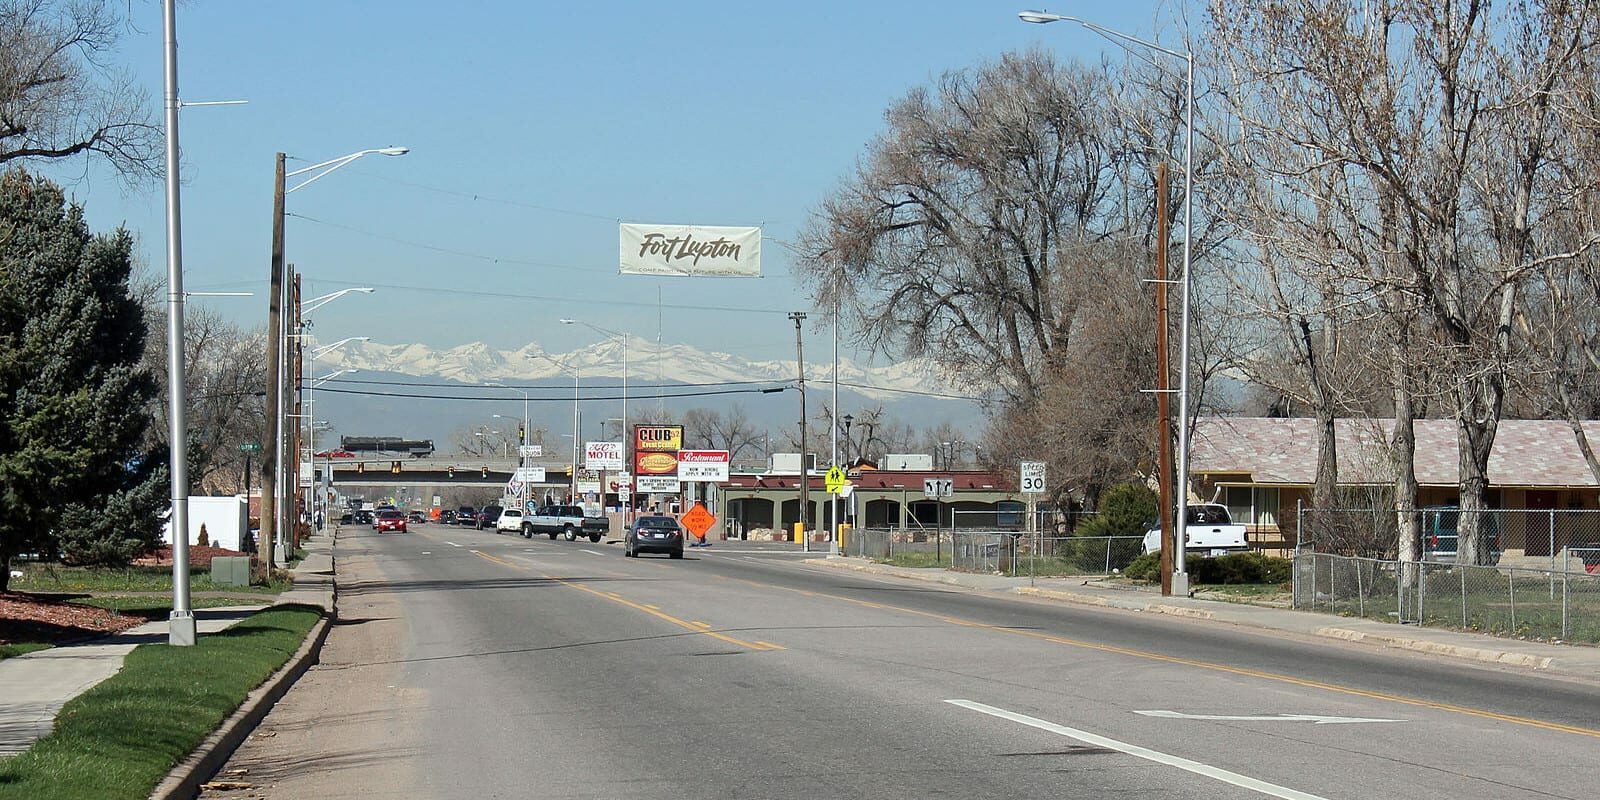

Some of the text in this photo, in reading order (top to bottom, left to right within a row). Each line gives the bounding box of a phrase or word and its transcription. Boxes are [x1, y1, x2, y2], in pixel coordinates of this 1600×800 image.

[639, 233, 741, 266] Fort Lupton
[640, 429, 671, 441] CLUB
[588, 451, 621, 459] MOTEL
[683, 452, 726, 463] Restaurant
[1023, 463, 1045, 471] SPEED
[1023, 478, 1044, 489] 30
